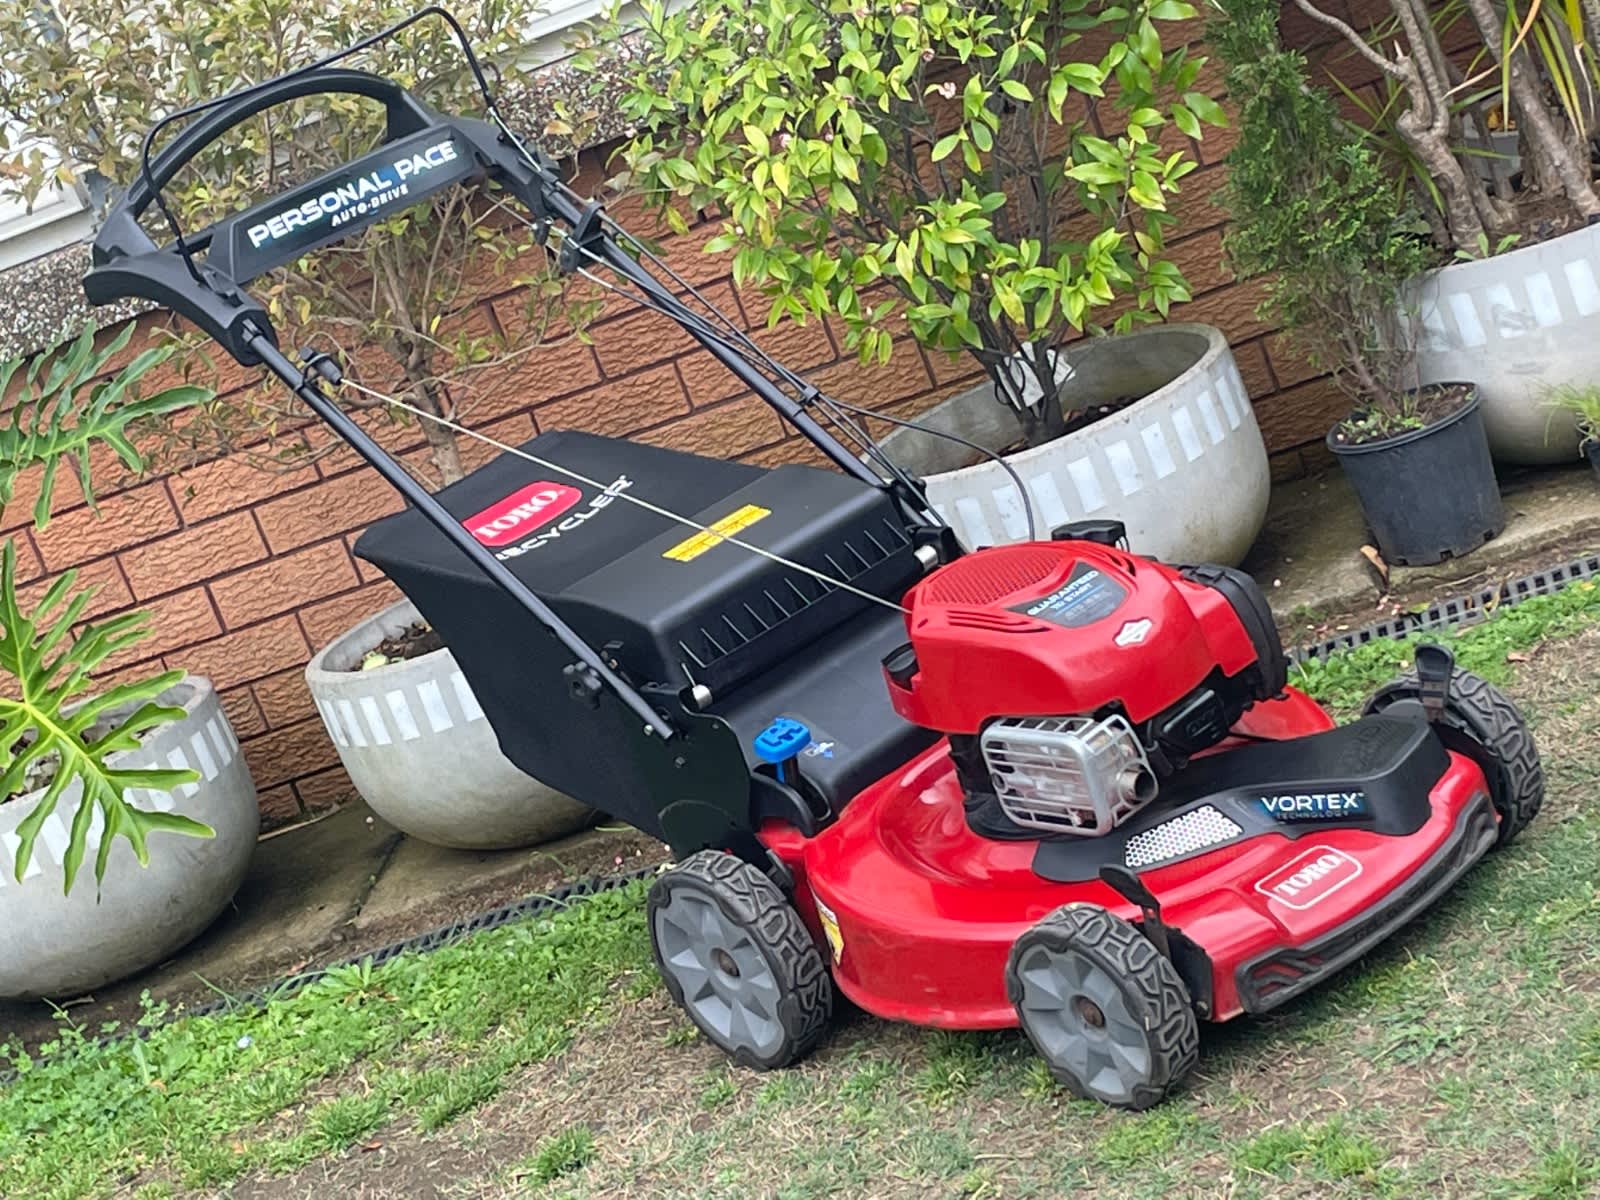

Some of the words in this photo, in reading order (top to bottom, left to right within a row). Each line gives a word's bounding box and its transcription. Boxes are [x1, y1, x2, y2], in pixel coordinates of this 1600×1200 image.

[247, 172, 393, 248] PERSONAL
[394, 141, 458, 181] PACE
[331, 184, 409, 227] AUTO-DRIVE
[475, 489, 562, 538] TORO
[1261, 792, 1360, 812] VORTEX
[1277, 809, 1349, 820] TECHNOLOGY
[1272, 853, 1343, 897] TORO
